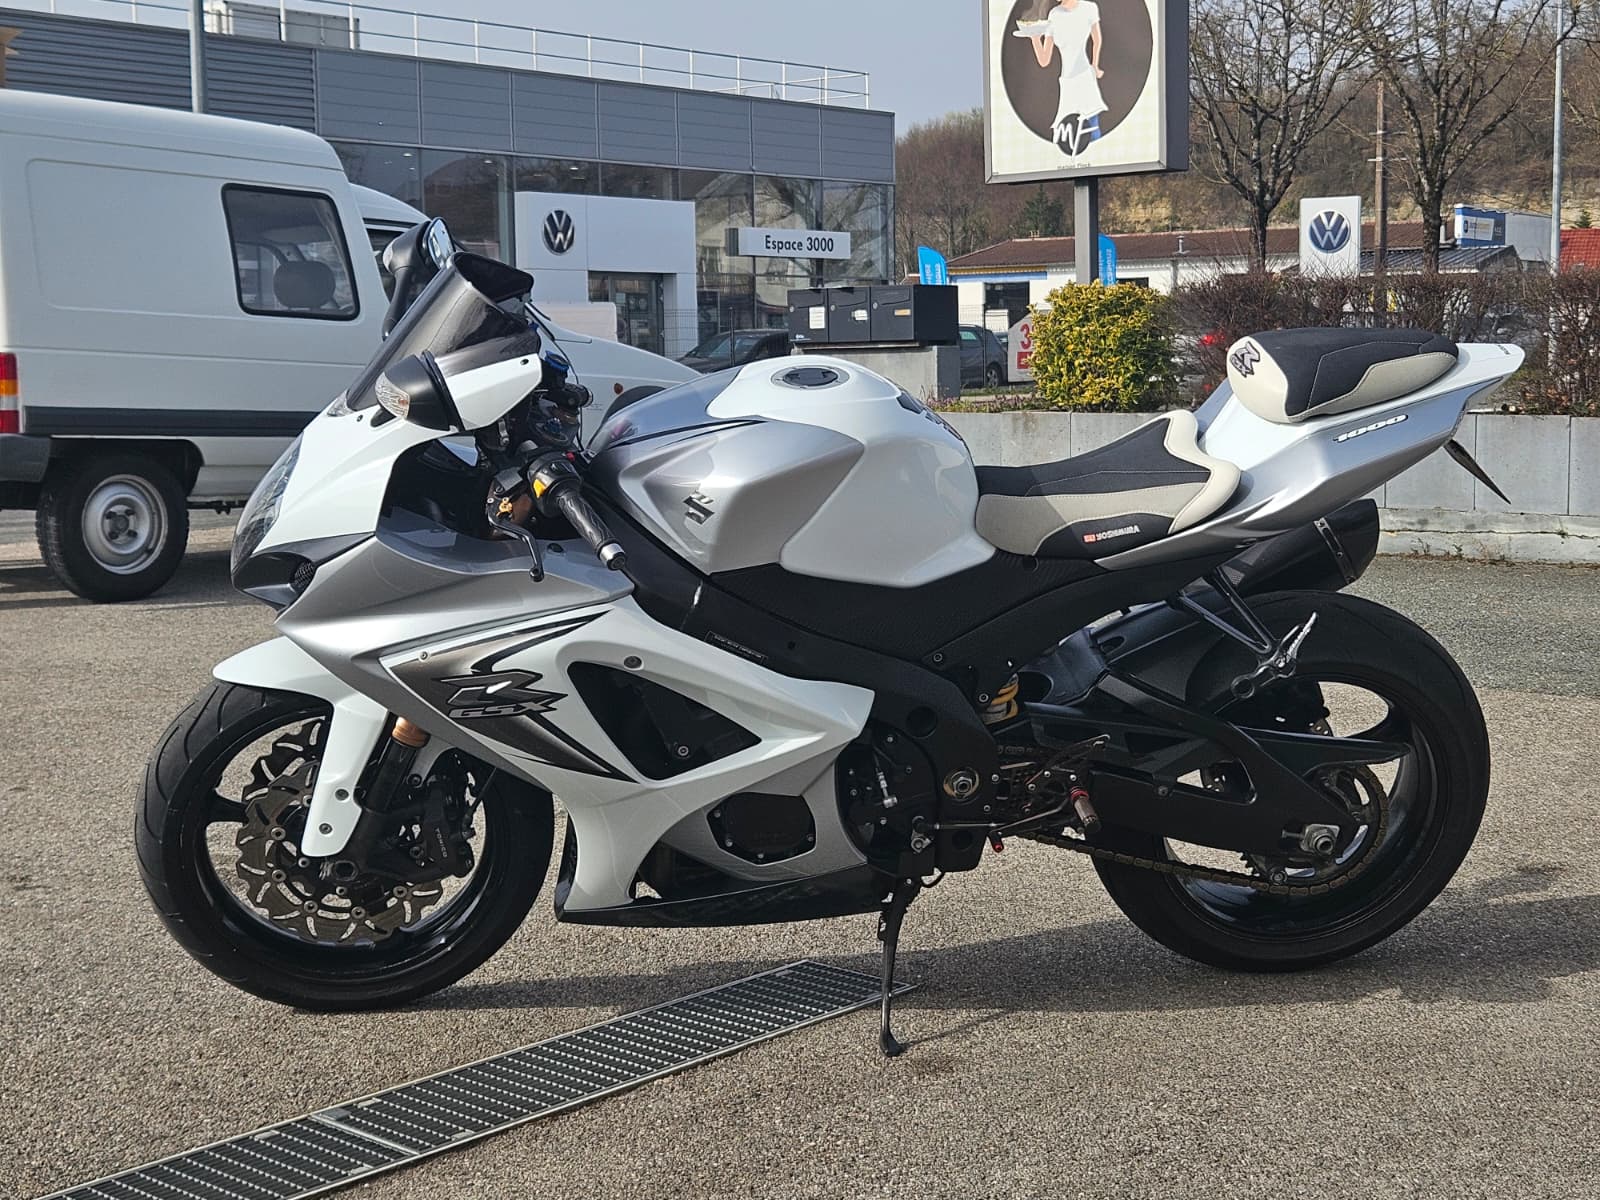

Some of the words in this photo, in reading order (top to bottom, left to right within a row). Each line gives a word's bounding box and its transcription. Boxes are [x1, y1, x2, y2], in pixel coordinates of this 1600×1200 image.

[764, 234, 803, 254] Espace
[806, 236, 834, 253] 3000
[1333, 414, 1409, 443] 1000
